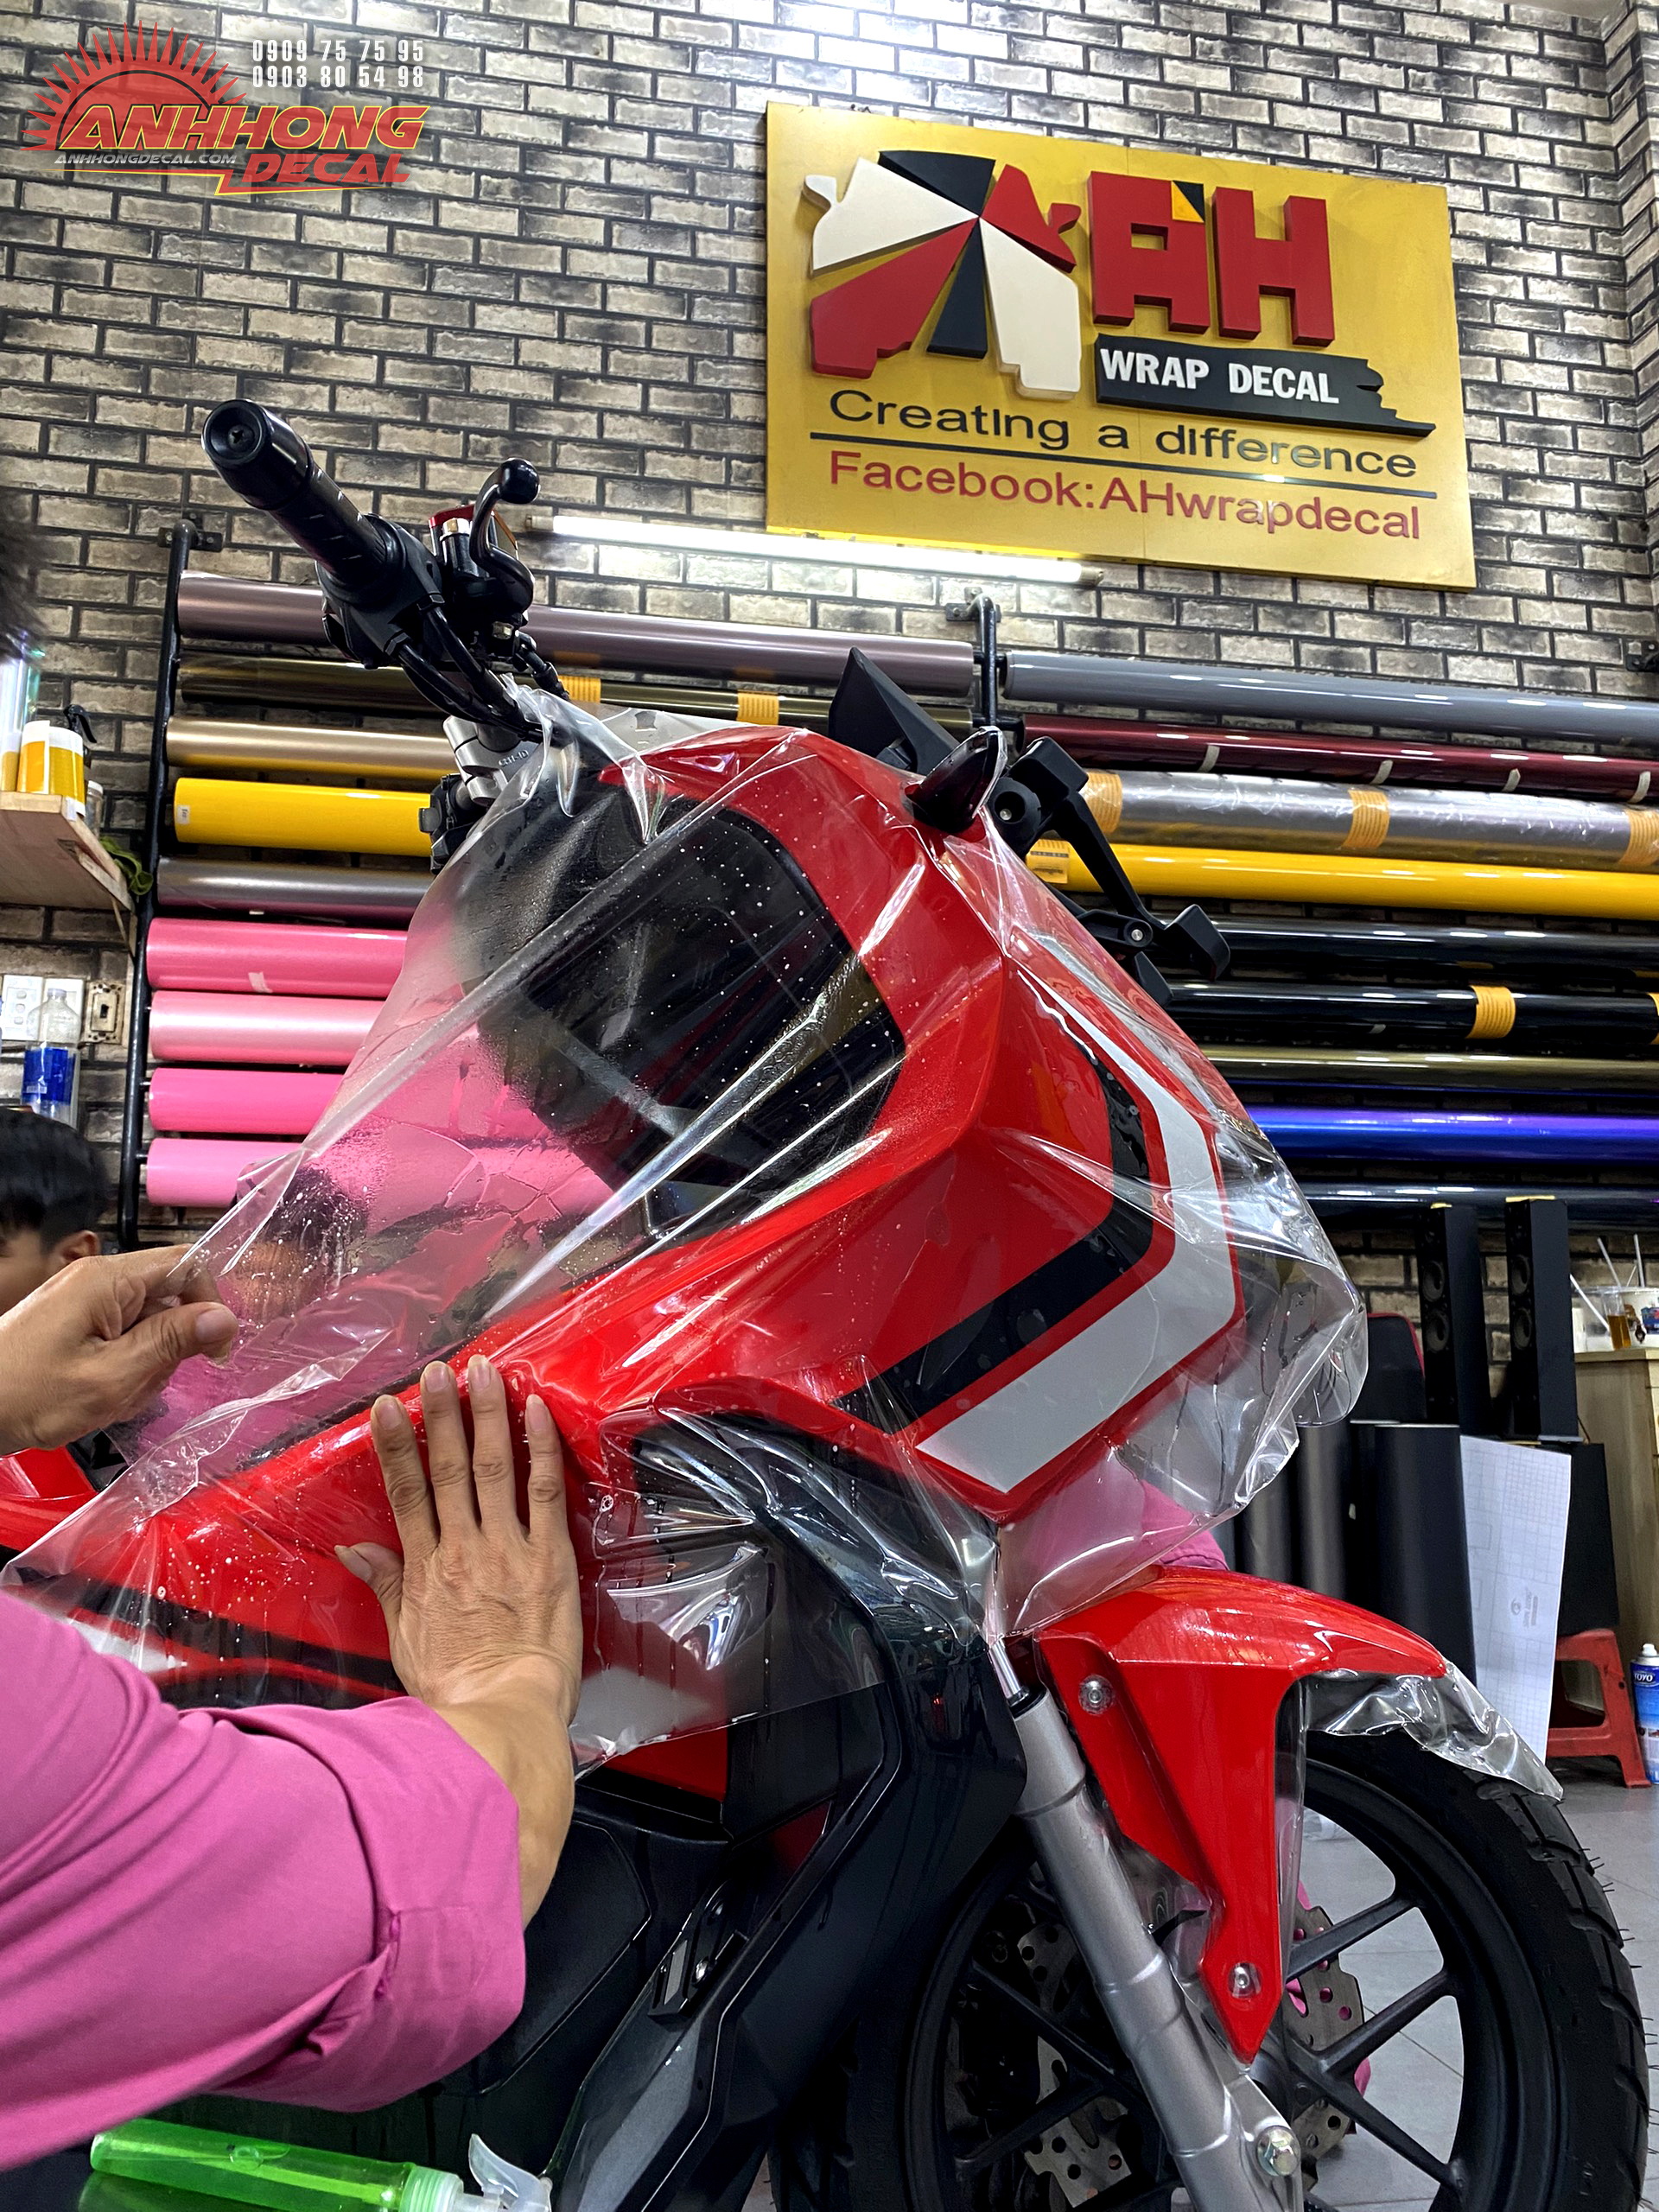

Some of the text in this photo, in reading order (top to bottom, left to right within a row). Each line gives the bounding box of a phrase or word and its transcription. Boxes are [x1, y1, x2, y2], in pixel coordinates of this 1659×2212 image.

[1087, 170, 1335, 347] AH
[1100, 348, 1339, 404] WRAP DECAL
[830, 390, 1417, 477] Creating a difference
